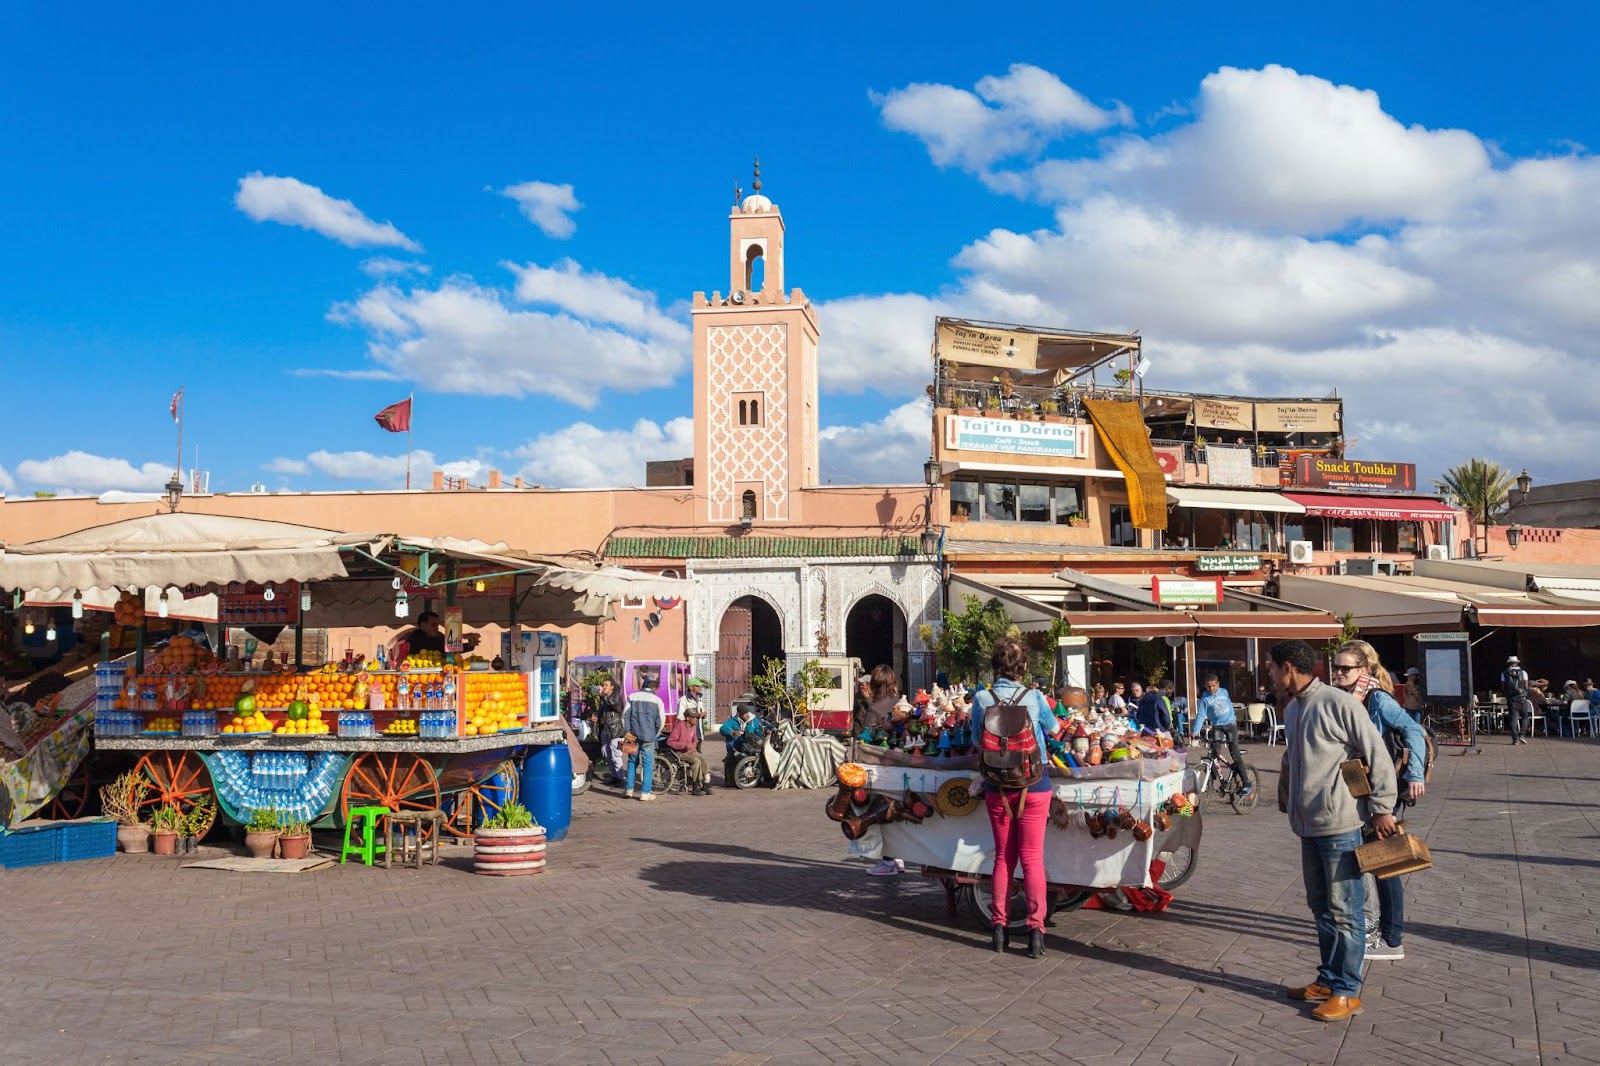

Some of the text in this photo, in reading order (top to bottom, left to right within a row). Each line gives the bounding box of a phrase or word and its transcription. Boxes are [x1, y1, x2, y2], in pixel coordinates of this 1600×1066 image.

[962, 419, 1073, 437] Taj'in Darna
[960, 442, 999, 451] TERRASSE
[1017, 445, 1074, 455] PANORAMIQUE
[1316, 460, 1397, 476] Snack Toubkal
[1358, 475, 1392, 484] Panoramique
